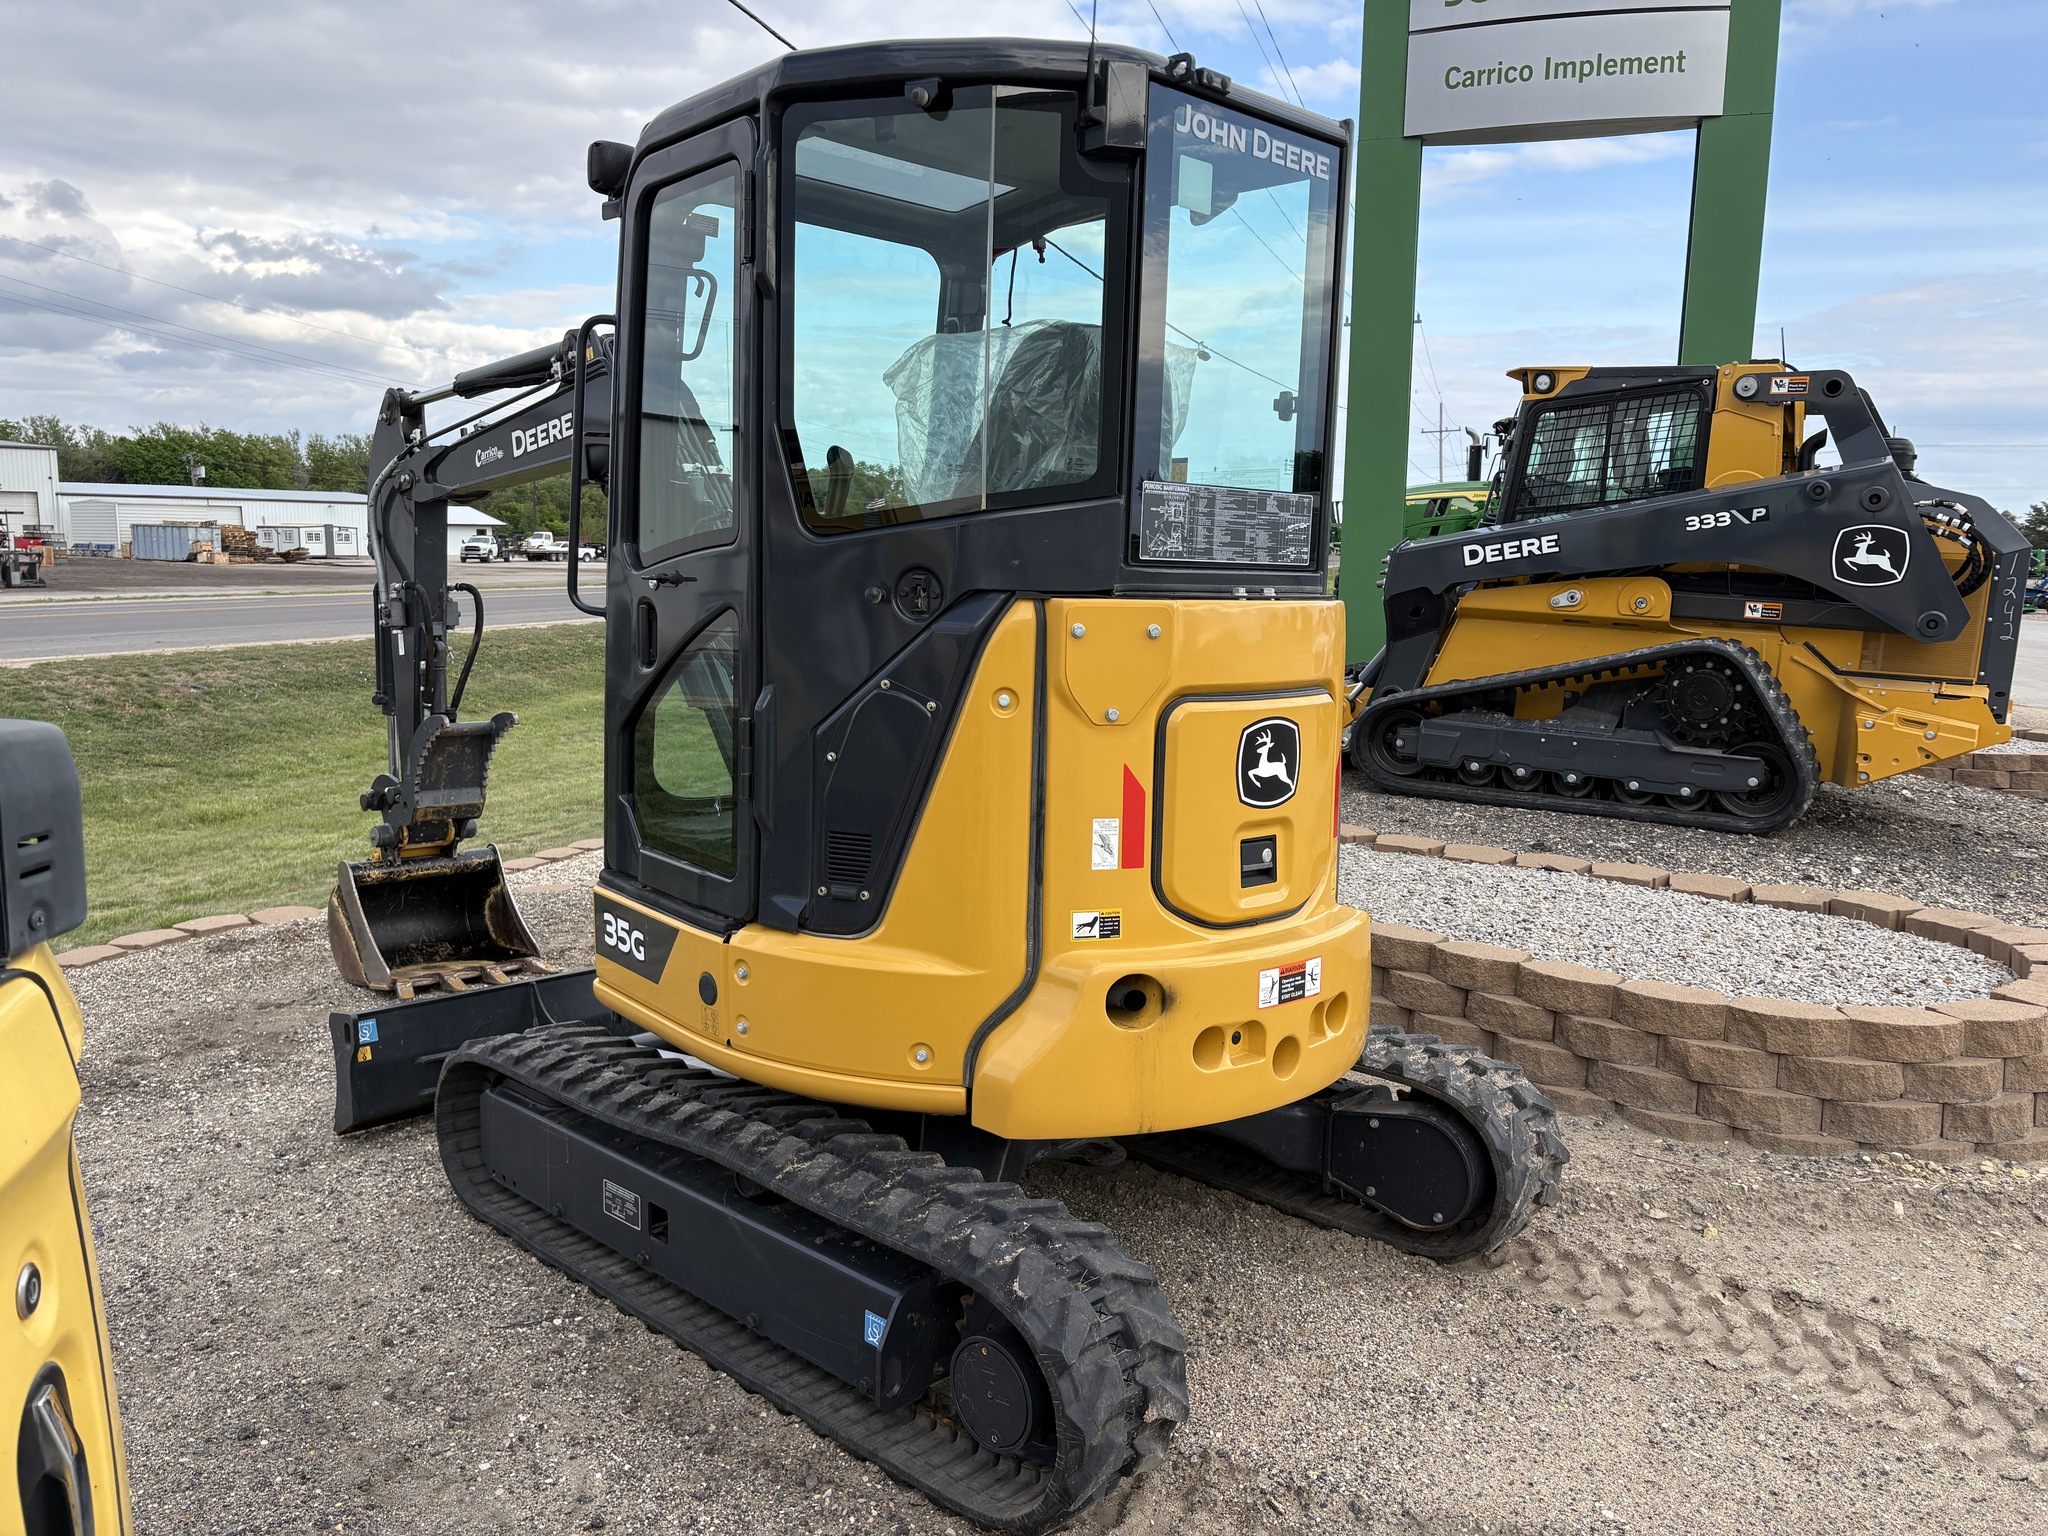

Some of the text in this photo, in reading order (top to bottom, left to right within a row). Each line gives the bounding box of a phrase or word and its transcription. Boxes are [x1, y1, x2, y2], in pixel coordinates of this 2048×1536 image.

[1444, 50, 1687, 90] Carrico Implement
[1176, 103, 1331, 181] JOHN DEERE
[511, 412, 574, 458] DEERE
[475, 446, 498, 468] Carrico
[1462, 534, 1560, 567] DEERE
[603, 912, 645, 961] 35G
[1285, 963, 1306, 974] WARNING
